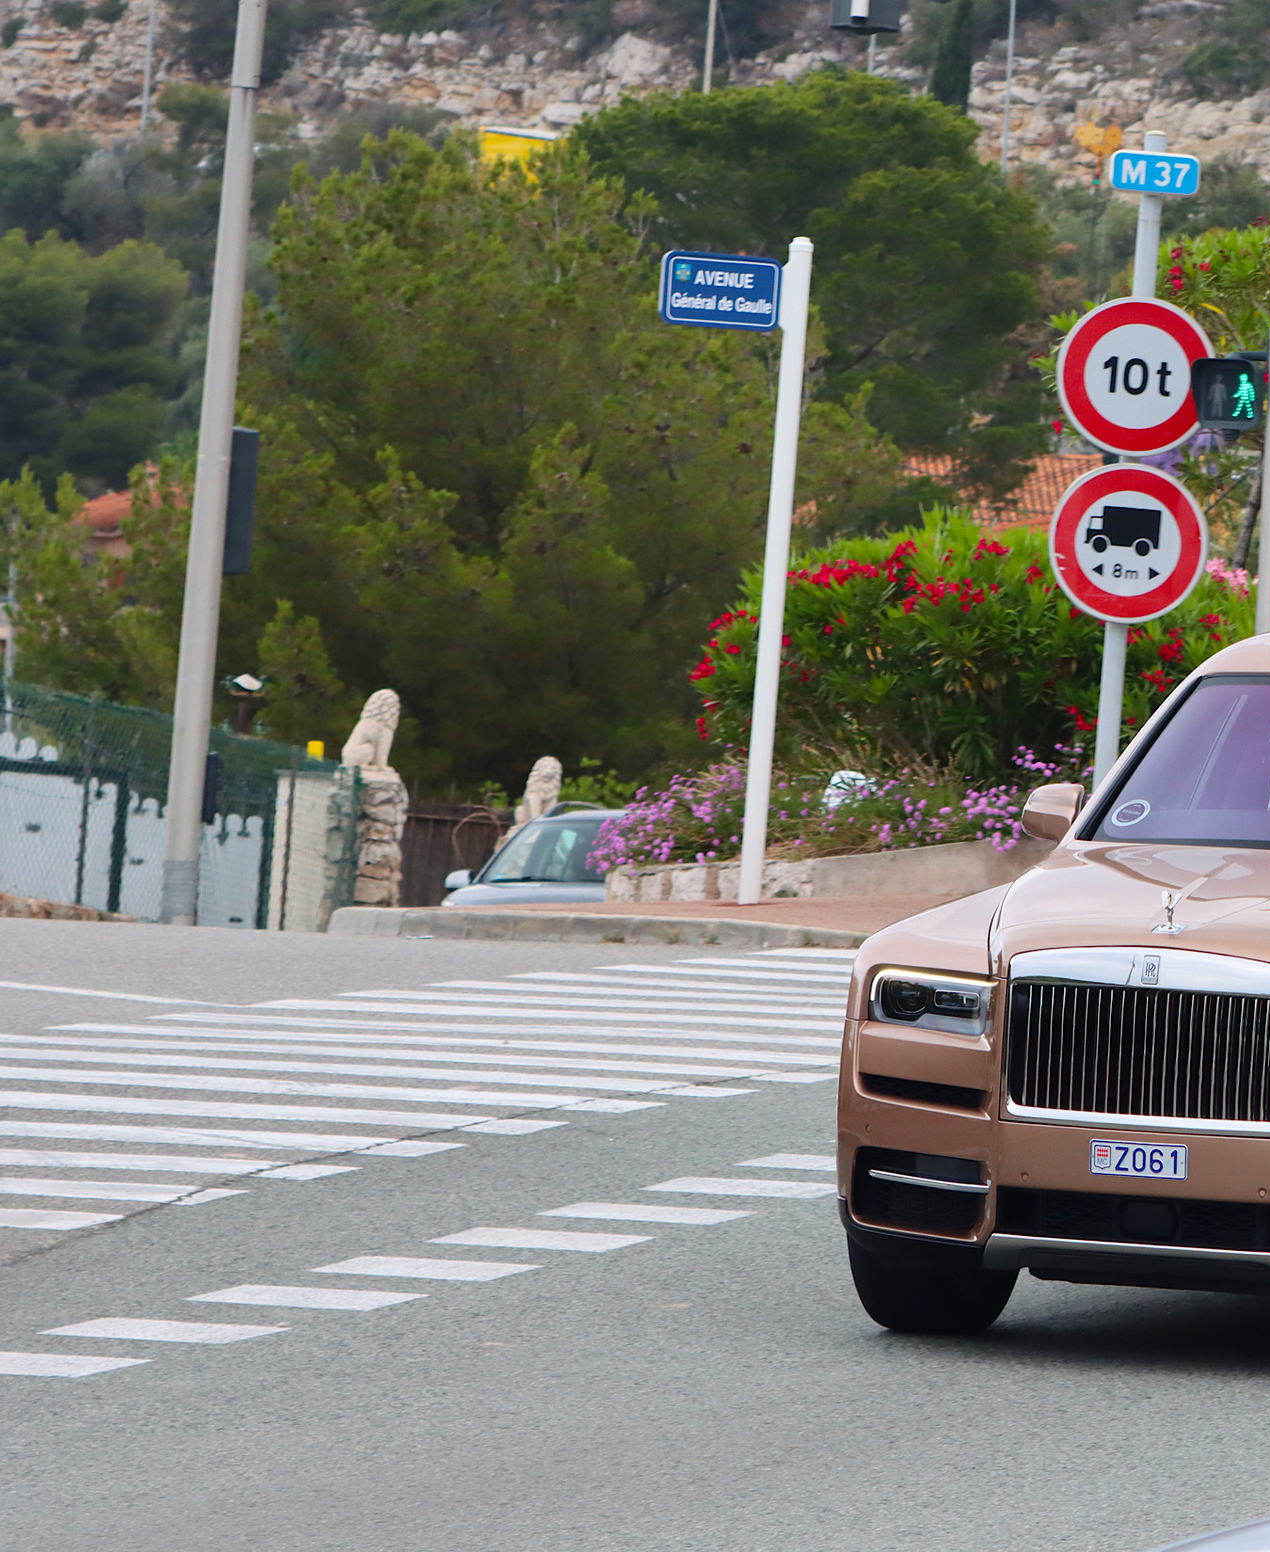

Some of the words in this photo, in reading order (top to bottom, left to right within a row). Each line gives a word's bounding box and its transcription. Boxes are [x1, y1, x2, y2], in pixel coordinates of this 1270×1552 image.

[1121, 159, 1147, 185] M
[1154, 161, 1191, 188] 37
[694, 269, 755, 289] AVENUE
[671, 292, 717, 310] Général
[717, 296, 734, 312] de
[734, 297, 773, 315] Gaulle
[1115, 1146, 1178, 1174] Z061
